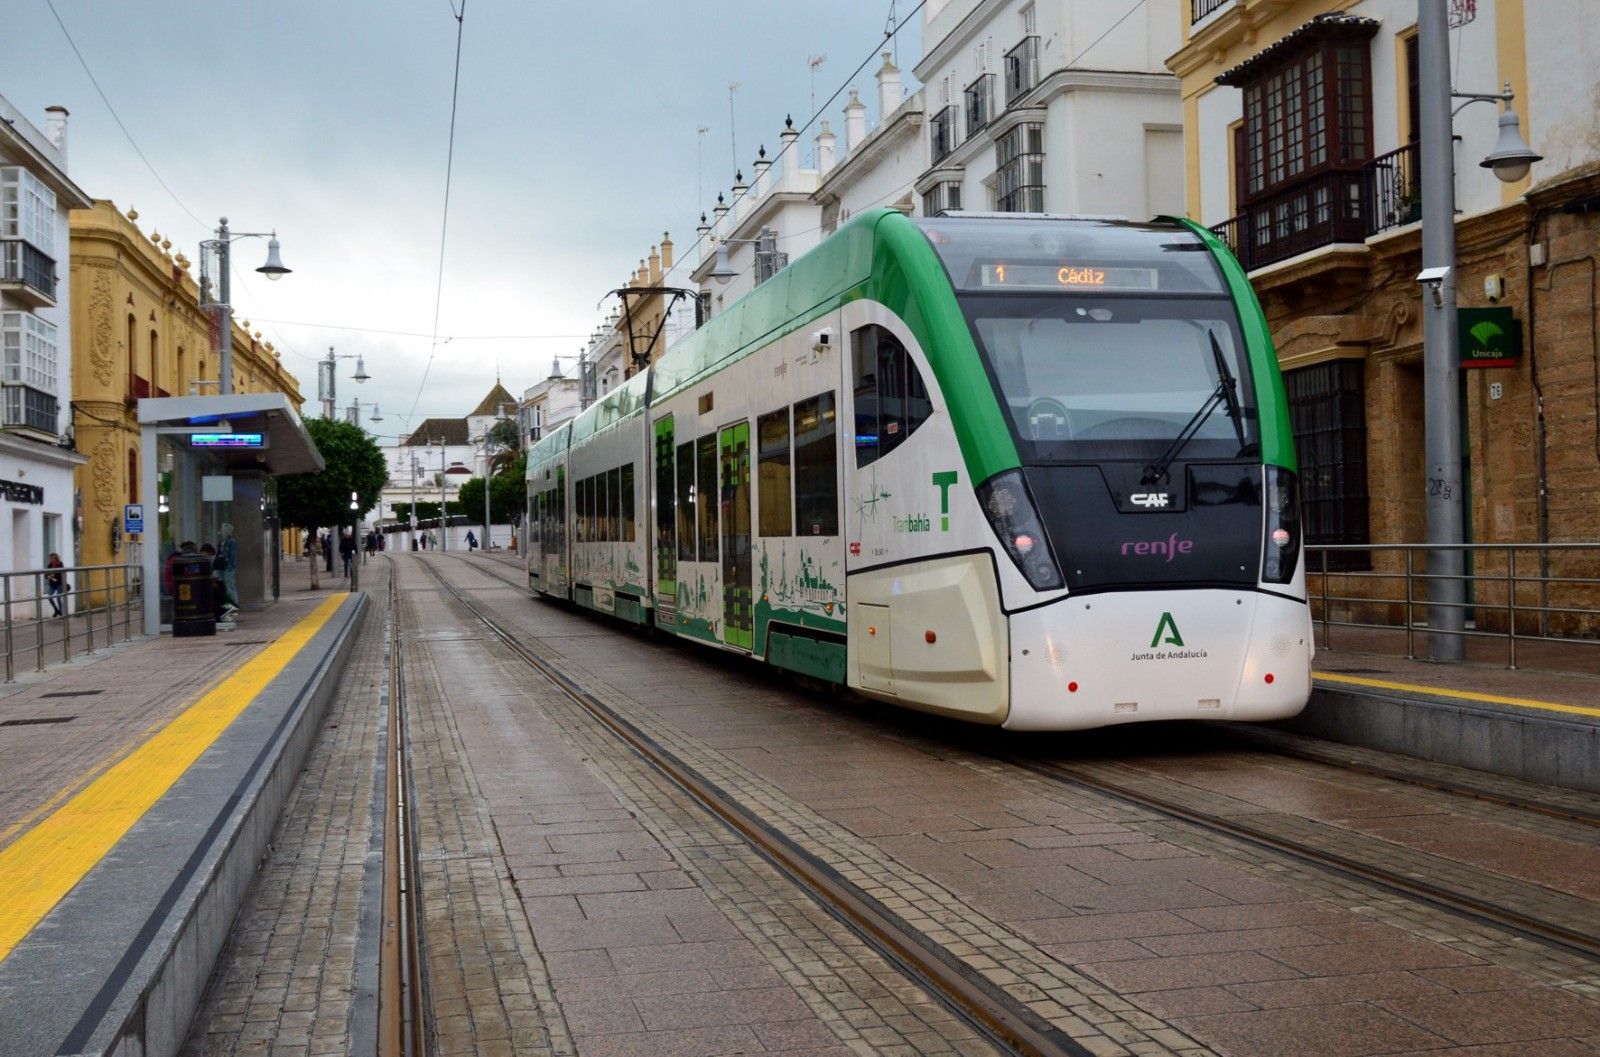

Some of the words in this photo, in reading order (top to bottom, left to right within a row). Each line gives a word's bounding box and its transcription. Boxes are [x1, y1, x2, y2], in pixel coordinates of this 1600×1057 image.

[995, 266, 1004, 283] 1
[1057, 267, 1105, 285] Cádiz
[1472, 349, 1503, 359] Unicaja
[1130, 493, 1168, 508] CAF
[1121, 532, 1194, 562] renfe
[1131, 652, 1154, 661] Junta
[1156, 652, 1166, 660] de
[1168, 649, 1208, 659] Andalucía
